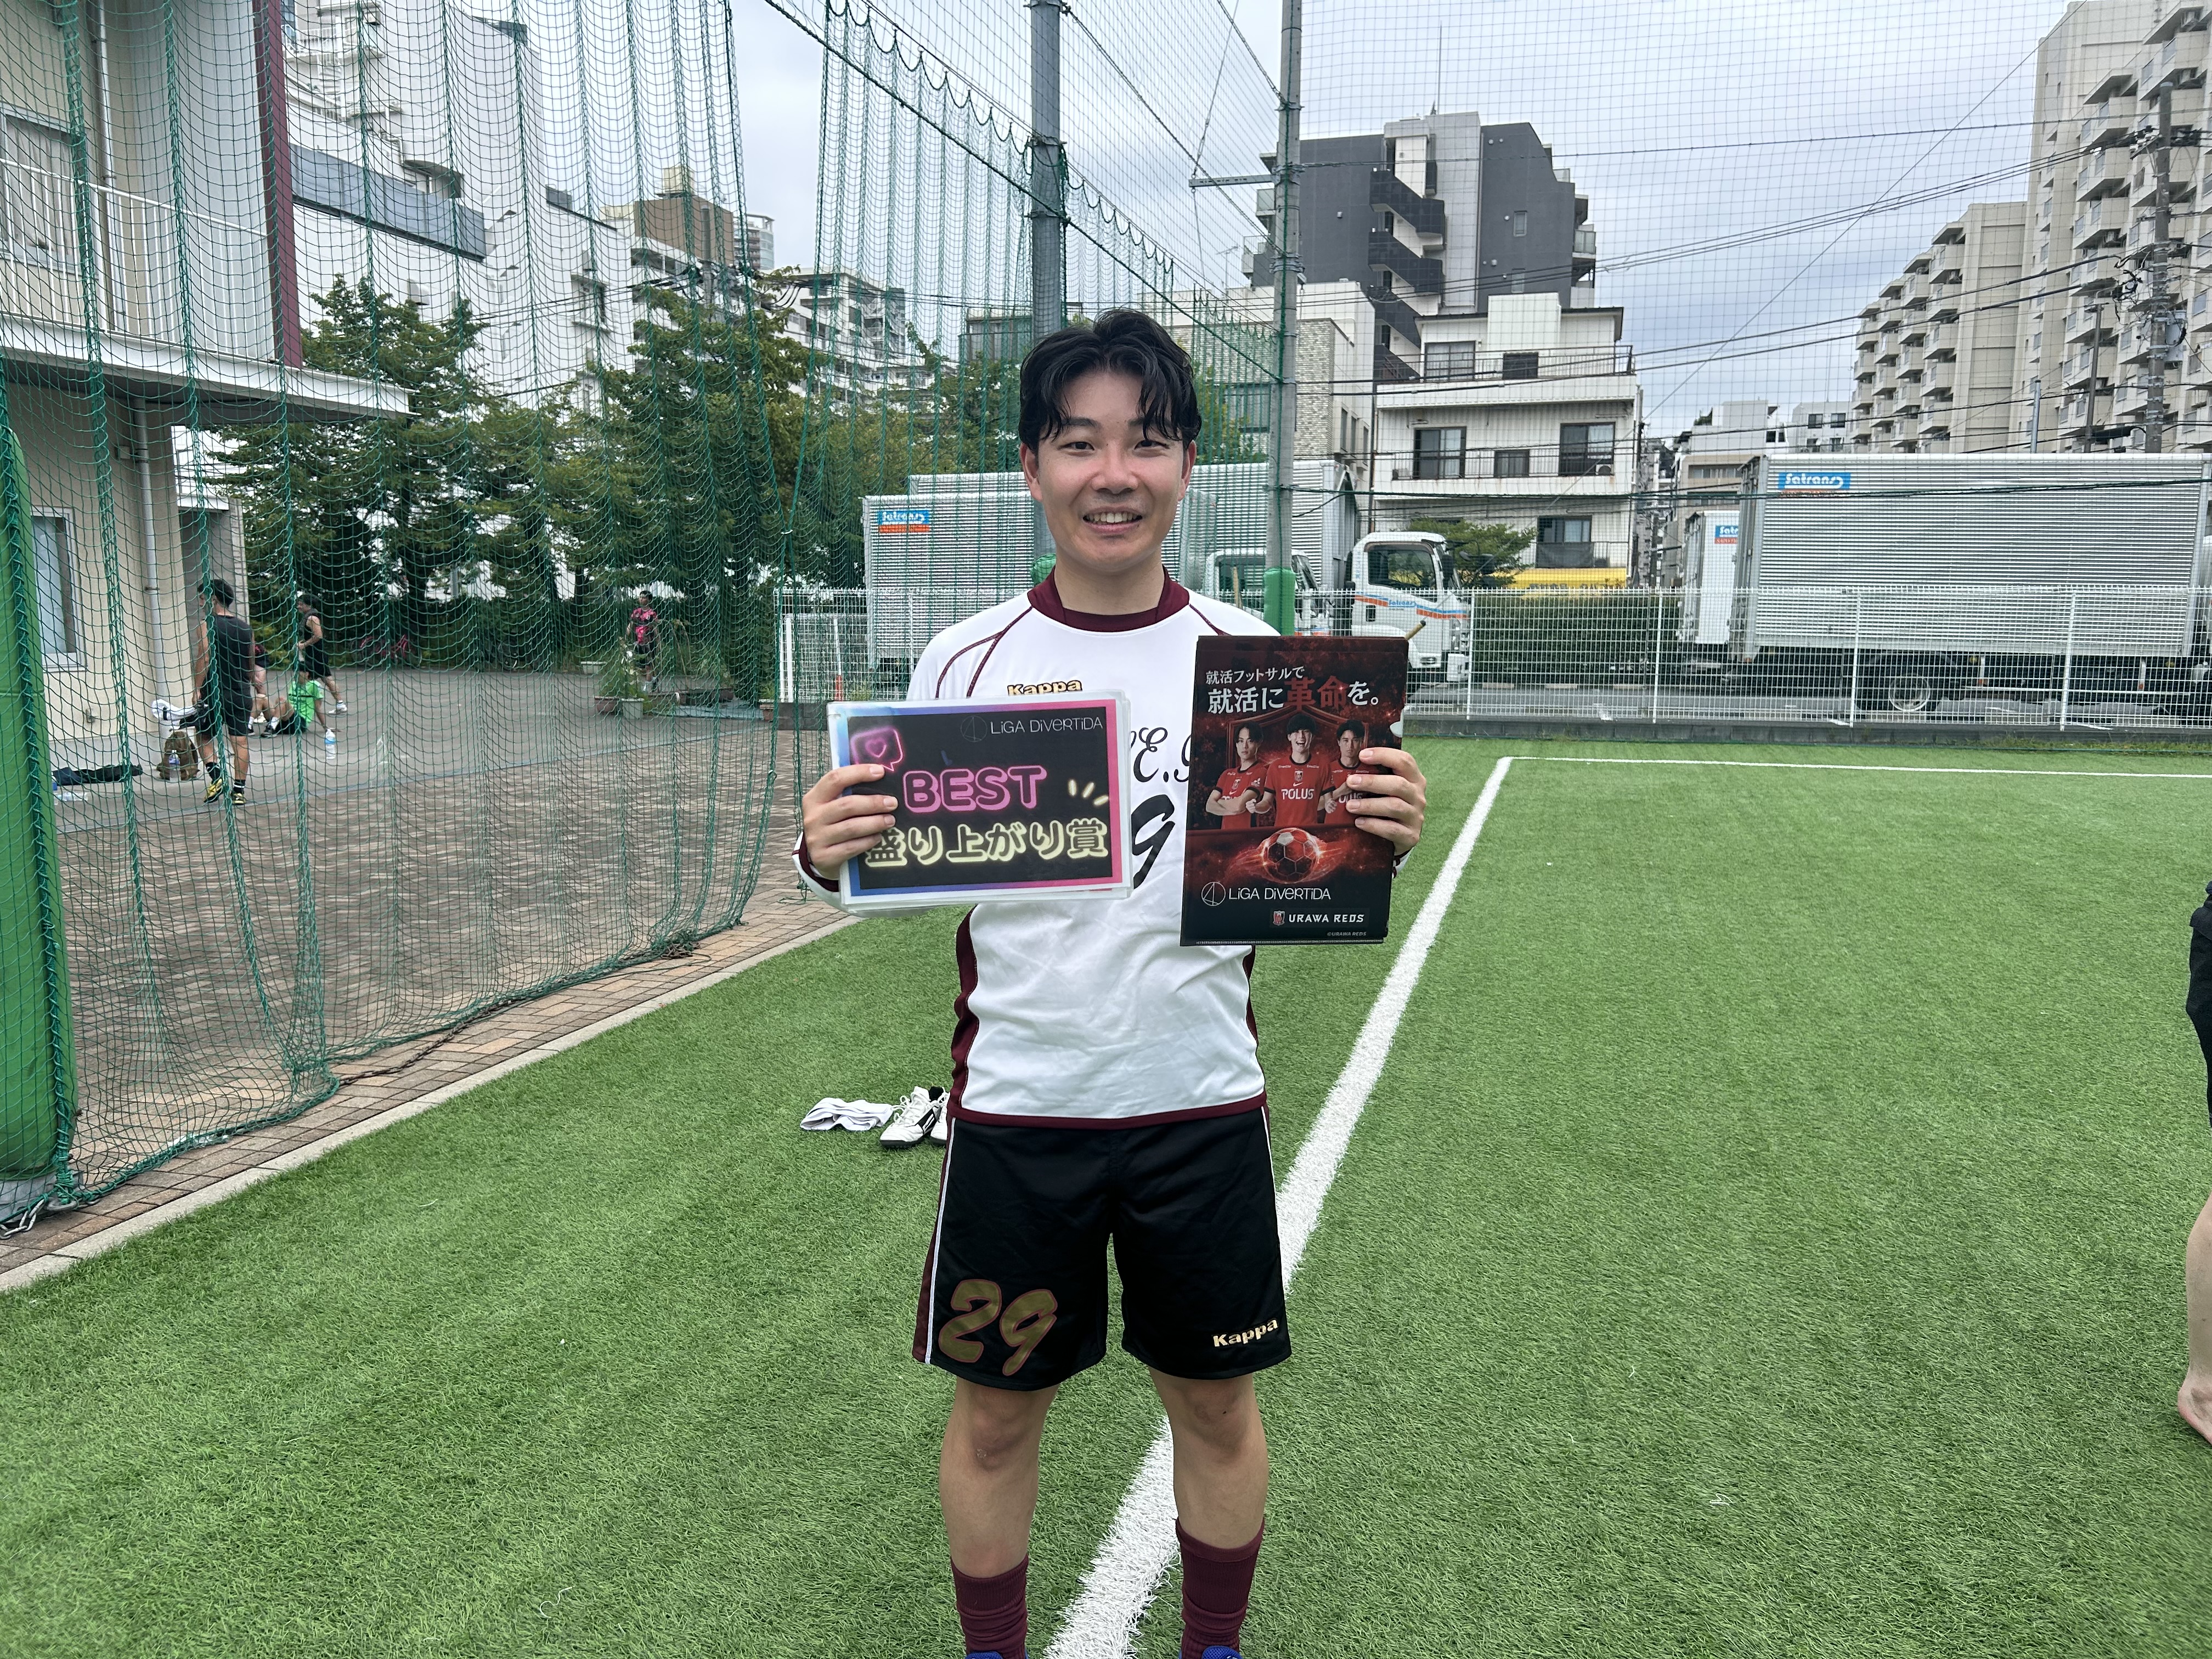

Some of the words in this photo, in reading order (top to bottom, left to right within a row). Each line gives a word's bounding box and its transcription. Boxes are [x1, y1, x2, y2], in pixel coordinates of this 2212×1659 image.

[1785, 473, 1843, 488] Satrans
[1206, 666, 1305, 685] 就活フットサルで
[1007, 680, 1082, 696] Kappa
[1208, 675, 1379, 714] 就活に革命を。
[903, 765, 1047, 813] BEST
[1281, 788, 1314, 800] POLUS
[865, 818, 1108, 867] 盛り上がり賞
[1289, 914, 1329, 923] URAWA
[1334, 914, 1364, 923] REDS
[938, 1279, 1058, 1376] 29
[1212, 1318, 1278, 1347] Kappa
